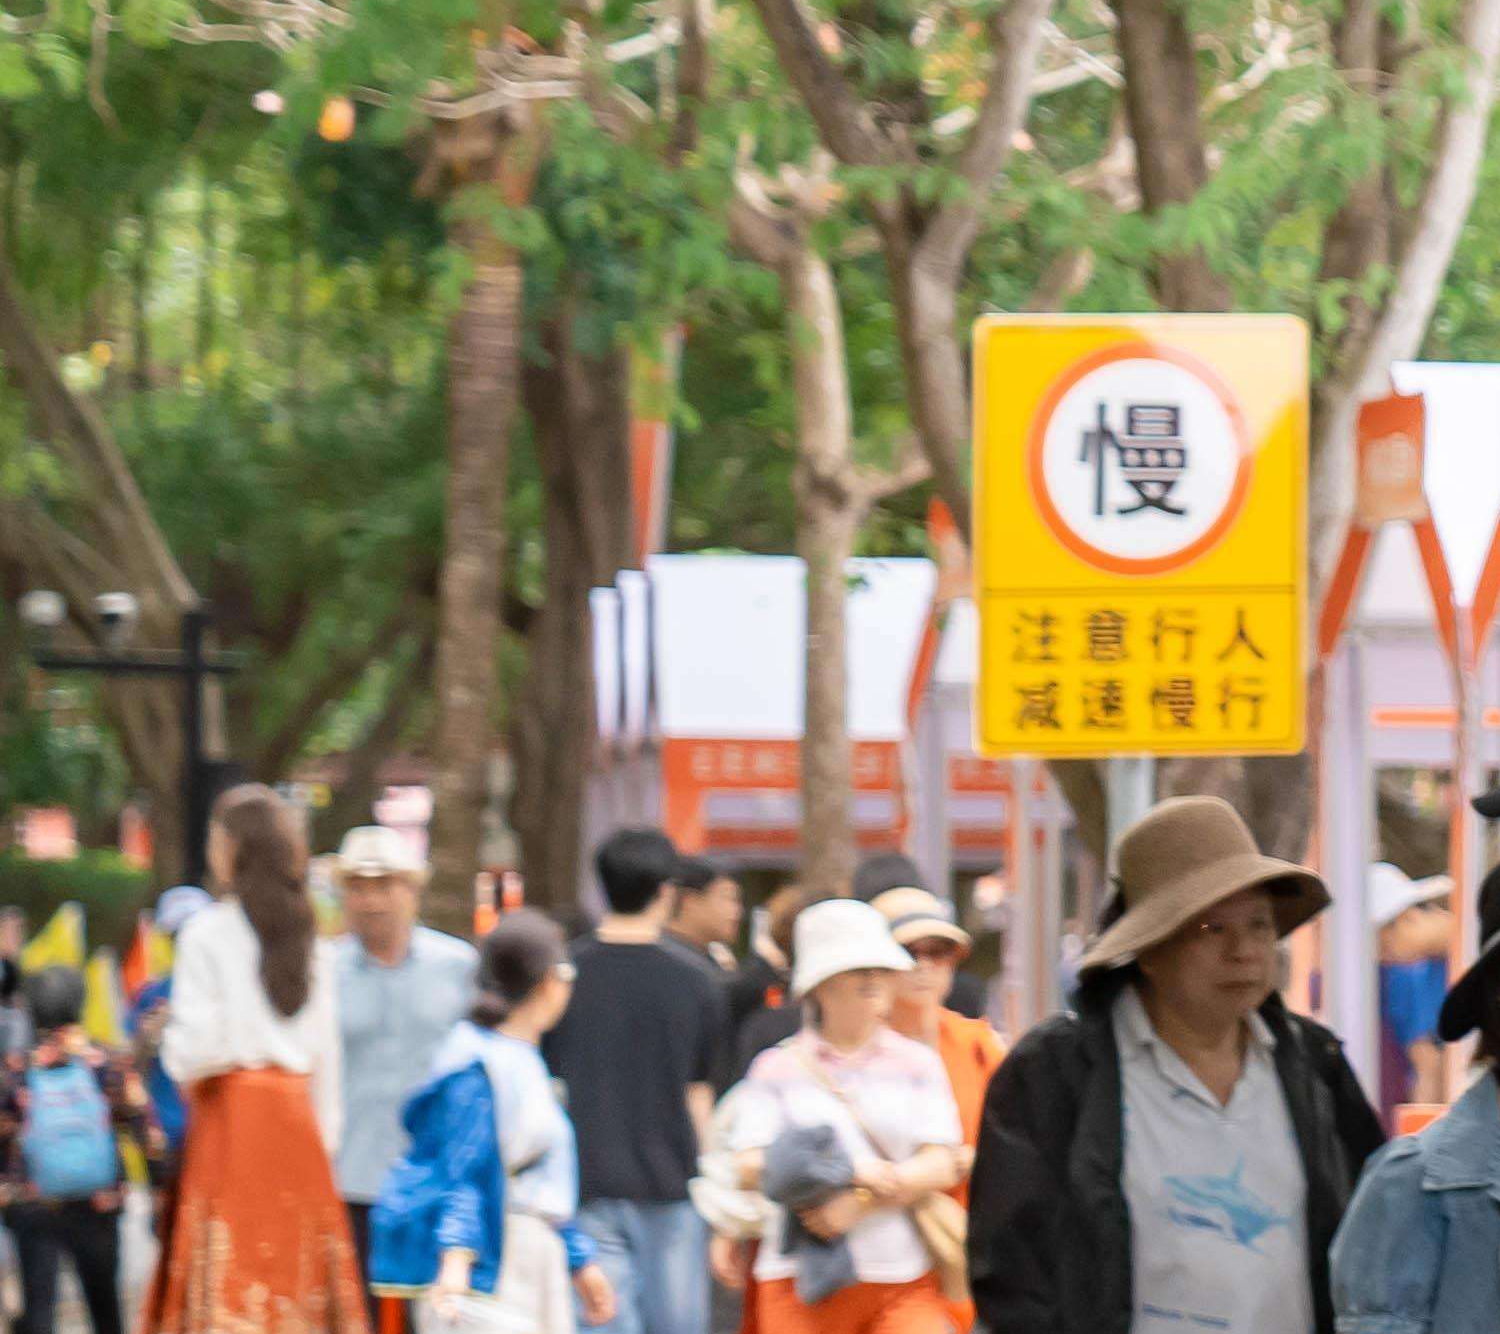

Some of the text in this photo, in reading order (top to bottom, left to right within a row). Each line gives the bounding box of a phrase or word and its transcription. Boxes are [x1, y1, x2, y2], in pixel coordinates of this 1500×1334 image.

[1078, 400, 1188, 516] 慢
[1010, 608, 1266, 664] 注意行人
[1012, 676, 1266, 731] 减速慢行
